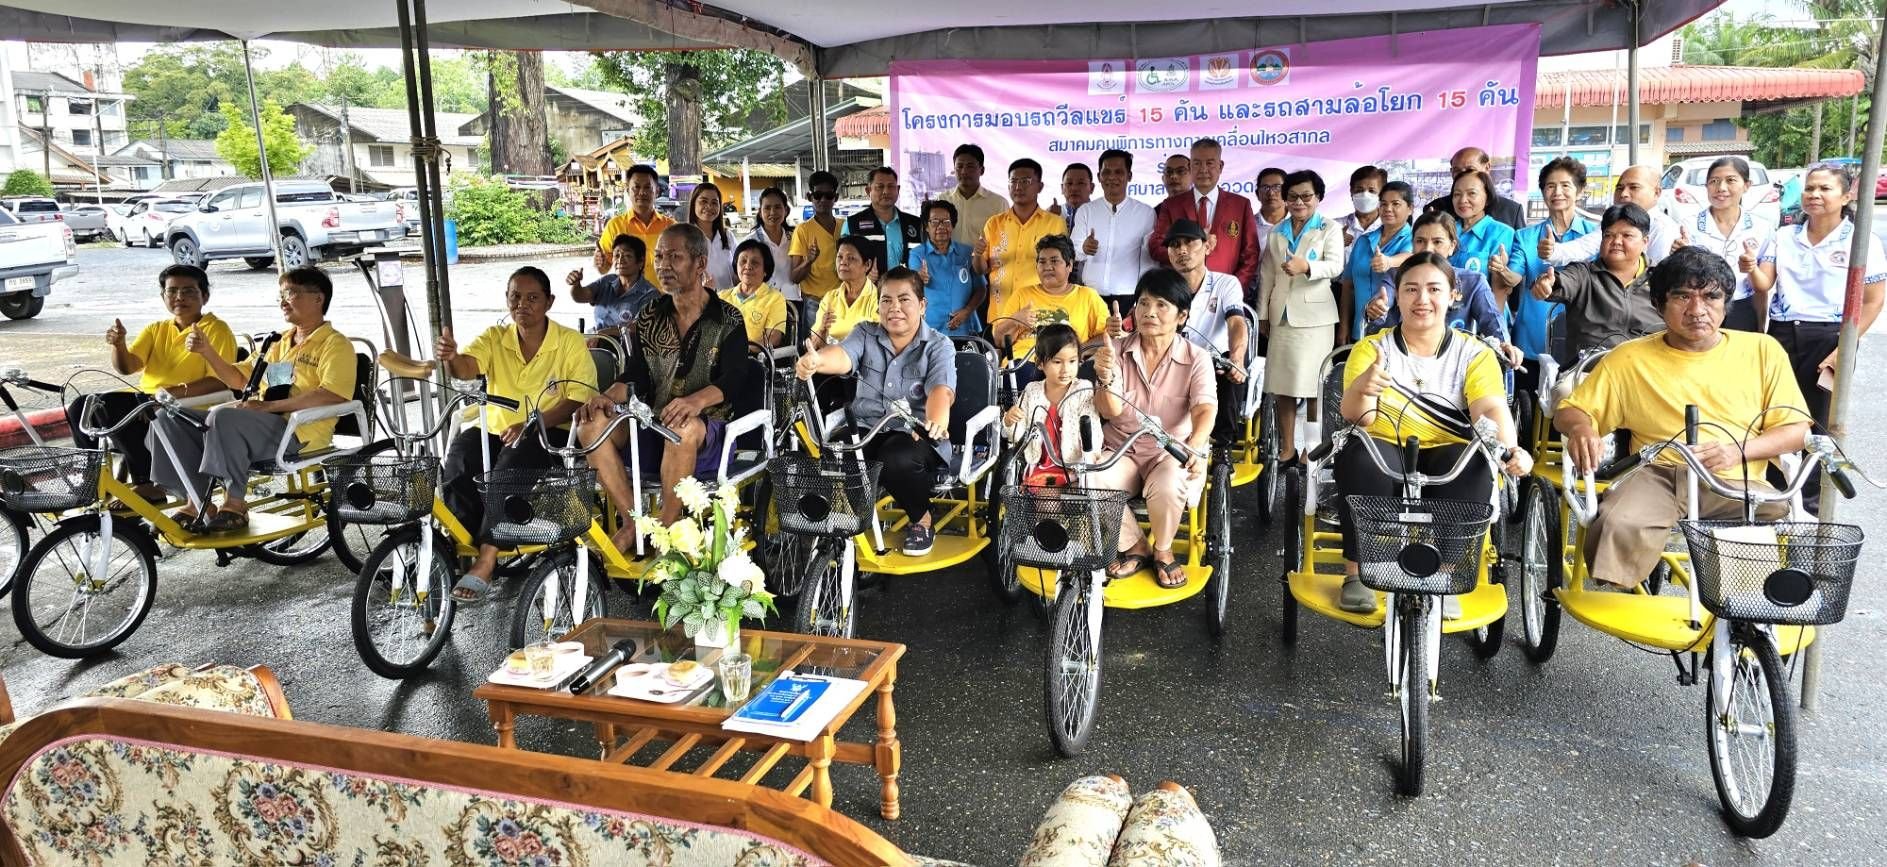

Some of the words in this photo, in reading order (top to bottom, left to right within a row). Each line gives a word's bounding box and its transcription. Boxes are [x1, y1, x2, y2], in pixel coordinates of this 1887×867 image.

[1140, 108, 1163, 122] 15
[1174, 100, 1208, 121] คัน
[1219, 82, 1422, 119] และรถสามล้อโยก
[1439, 91, 1466, 109] 15
[1479, 81, 1519, 106] คัน
